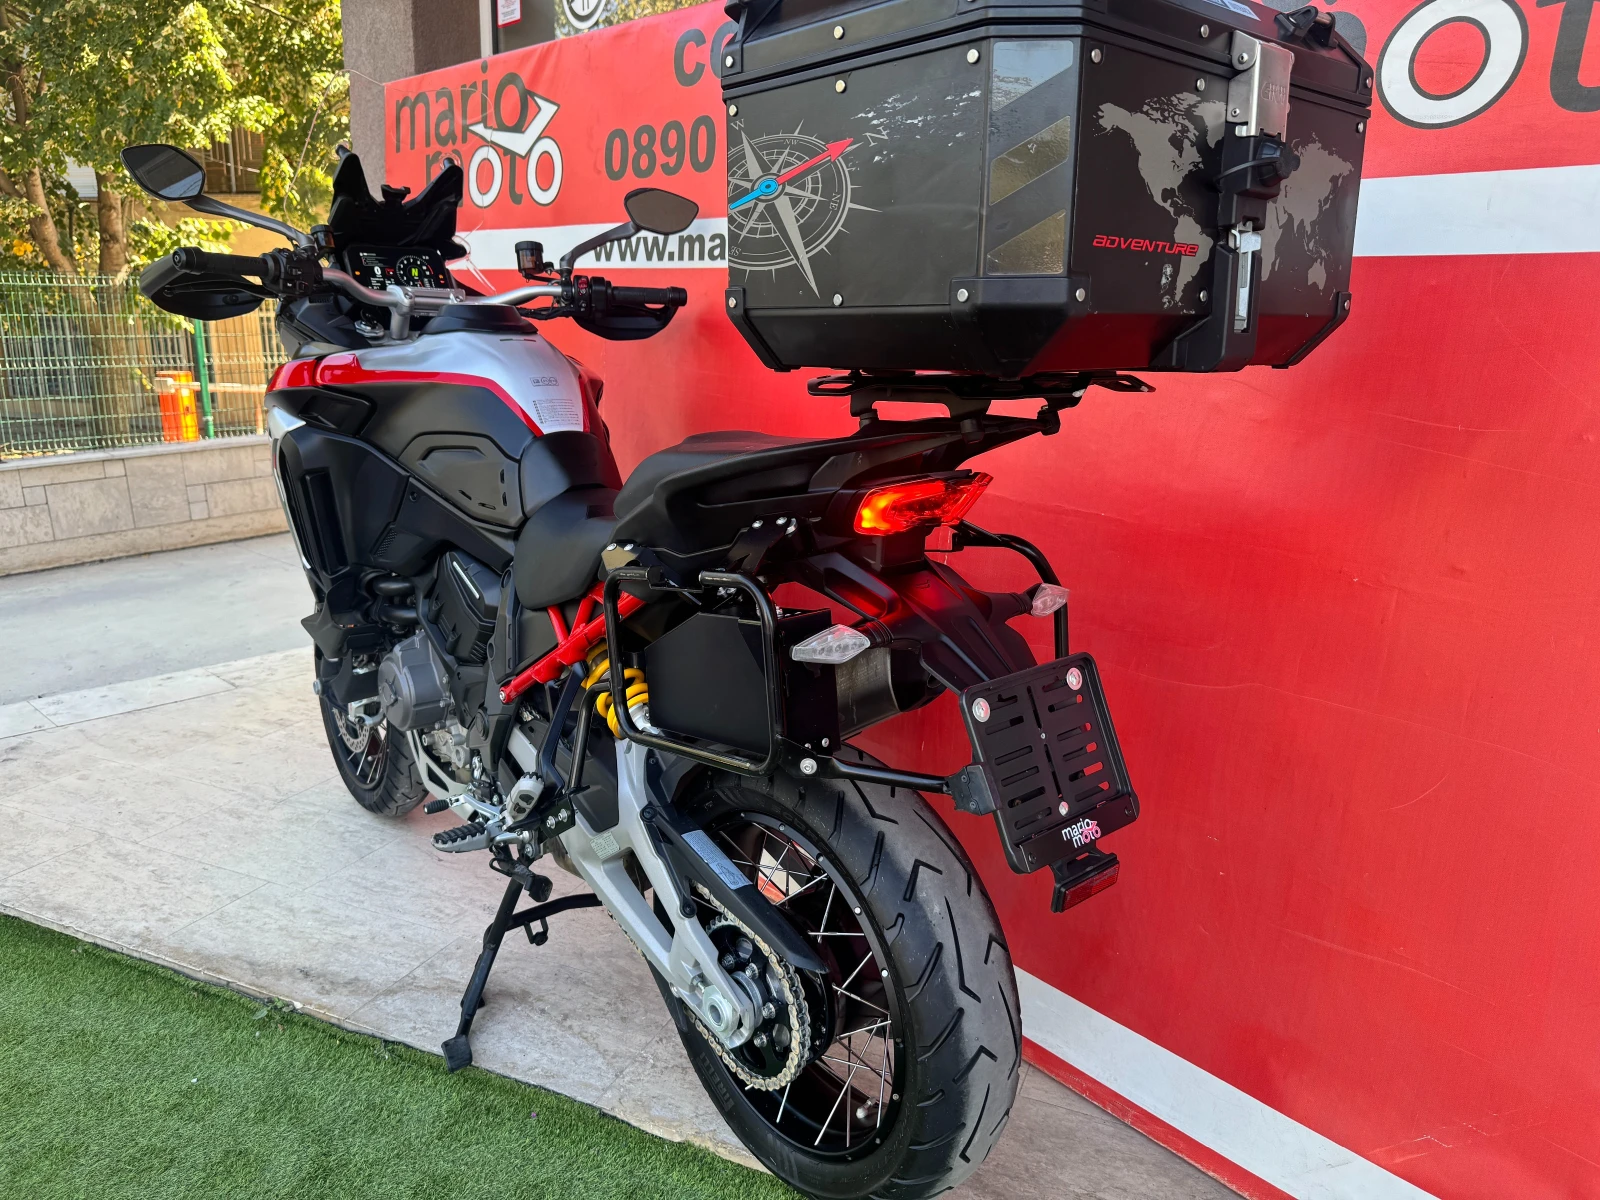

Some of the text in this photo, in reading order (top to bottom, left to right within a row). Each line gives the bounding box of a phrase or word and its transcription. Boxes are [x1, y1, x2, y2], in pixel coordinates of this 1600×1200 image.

[395, 60, 530, 153] mario
[730, 118, 746, 131] W
[604, 114, 717, 181] 0890
[1061, 817, 1092, 842] mario
[1072, 825, 1102, 849] moto
